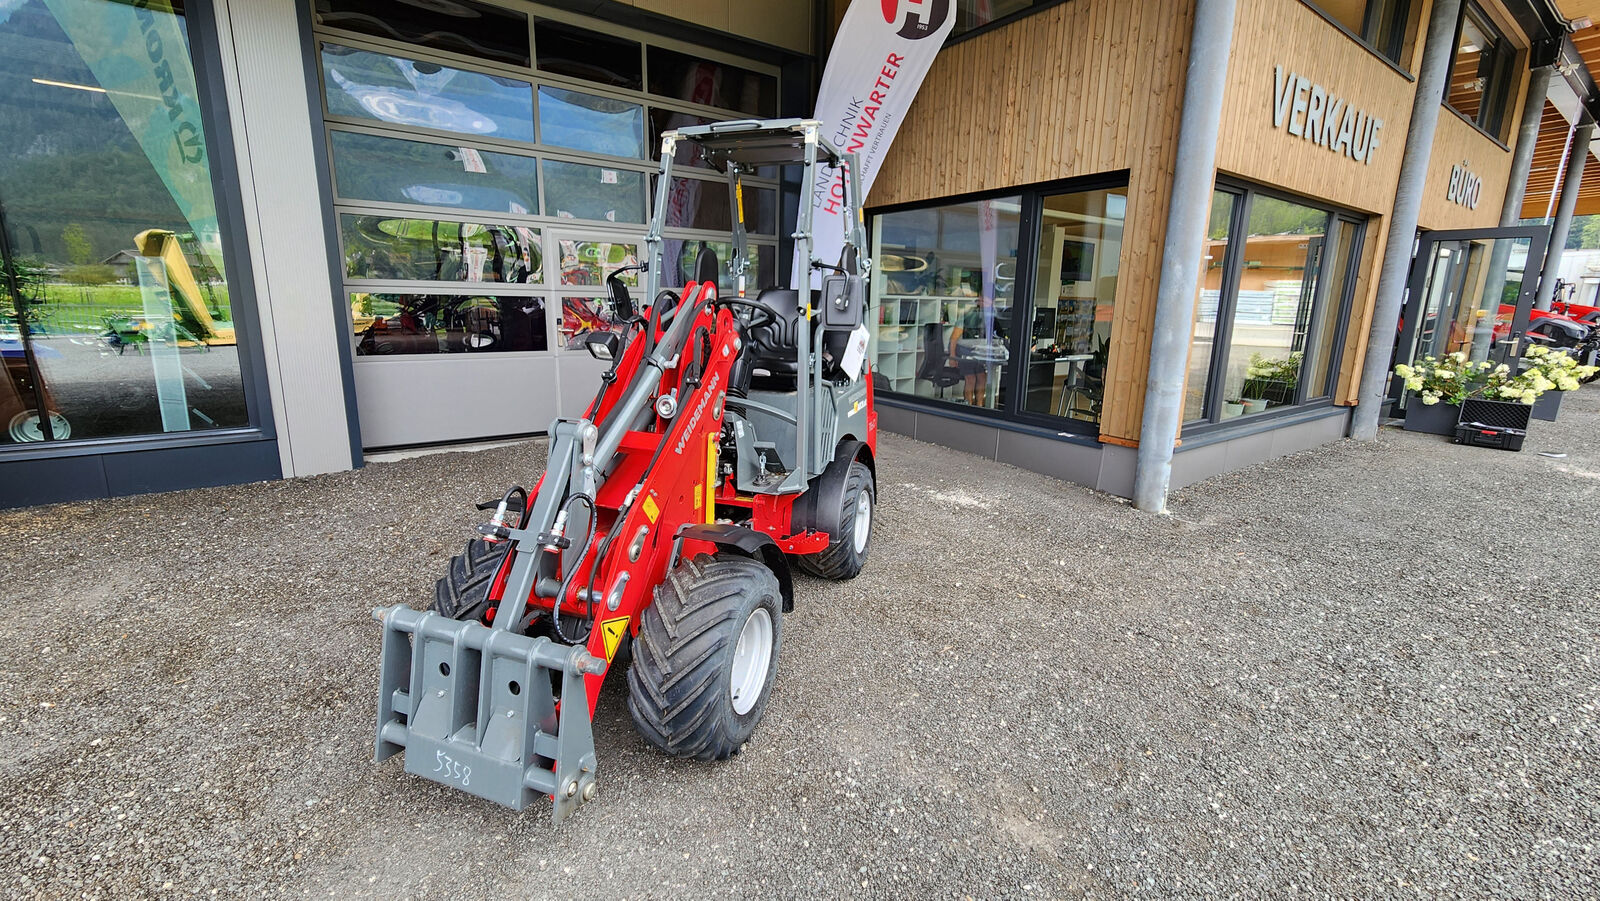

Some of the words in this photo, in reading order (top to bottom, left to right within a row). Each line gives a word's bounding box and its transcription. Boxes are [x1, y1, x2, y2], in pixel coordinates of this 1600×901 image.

[916, 23, 929, 31] 1953
[824, 52, 905, 216] HONWARTER
[870, 113, 892, 154] VERTRAUEN
[1273, 64, 1384, 166] VERKAUF
[813, 96, 864, 209] LANDCHNIK
[1447, 159, 1482, 211] BÜRO
[675, 371, 720, 455] WEIDEMANN
[433, 750, 471, 786] 5358
